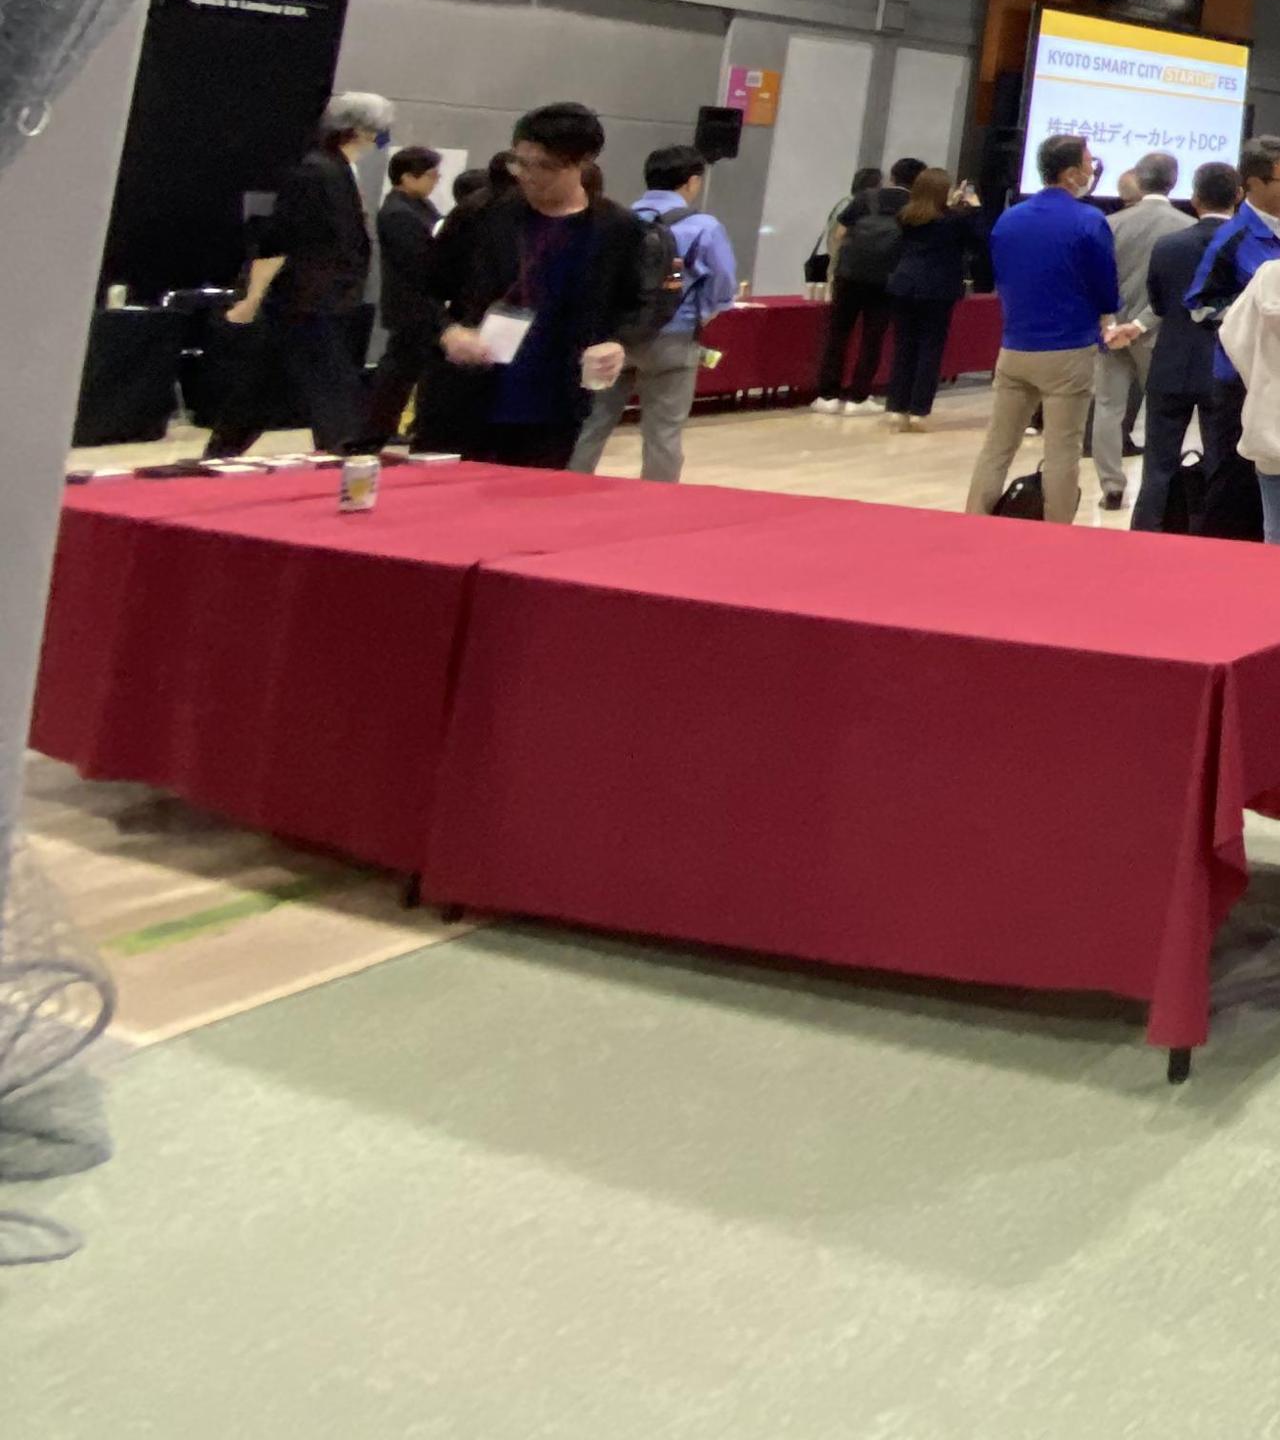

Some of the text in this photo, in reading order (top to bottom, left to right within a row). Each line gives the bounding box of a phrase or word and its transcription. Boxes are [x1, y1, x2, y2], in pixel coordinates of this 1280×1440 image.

[1048, 50, 1090, 69] KYOTO
[1093, 57, 1136, 76] SMART
[1137, 63, 1164, 80] CITY
[1218, 76, 1237, 91] FES
